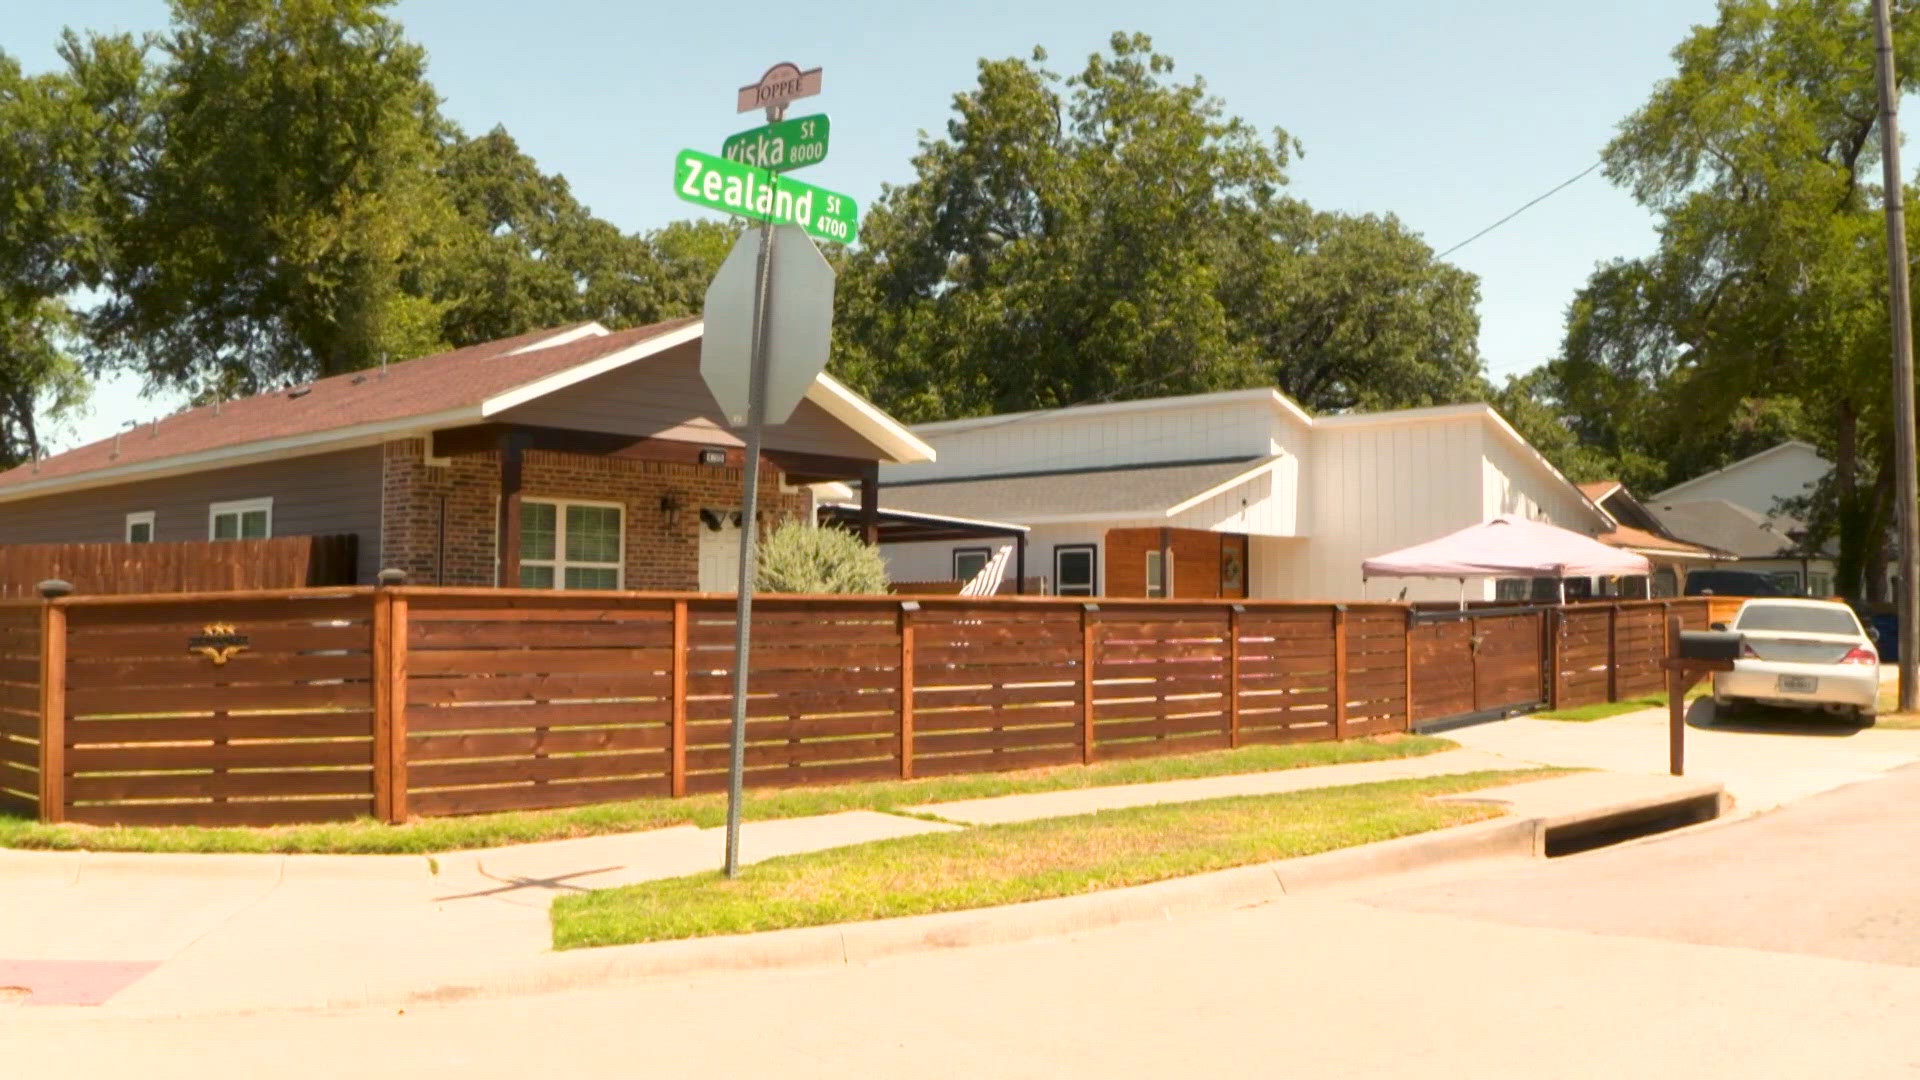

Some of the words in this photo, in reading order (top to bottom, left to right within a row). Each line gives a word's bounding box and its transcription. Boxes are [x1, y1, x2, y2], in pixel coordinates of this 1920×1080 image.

[801, 120, 815, 140] St
[789, 142, 823, 164] 8000
[682, 158, 813, 227] Zealand
[826, 195, 842, 214] St
[816, 215, 848, 239] 4700
